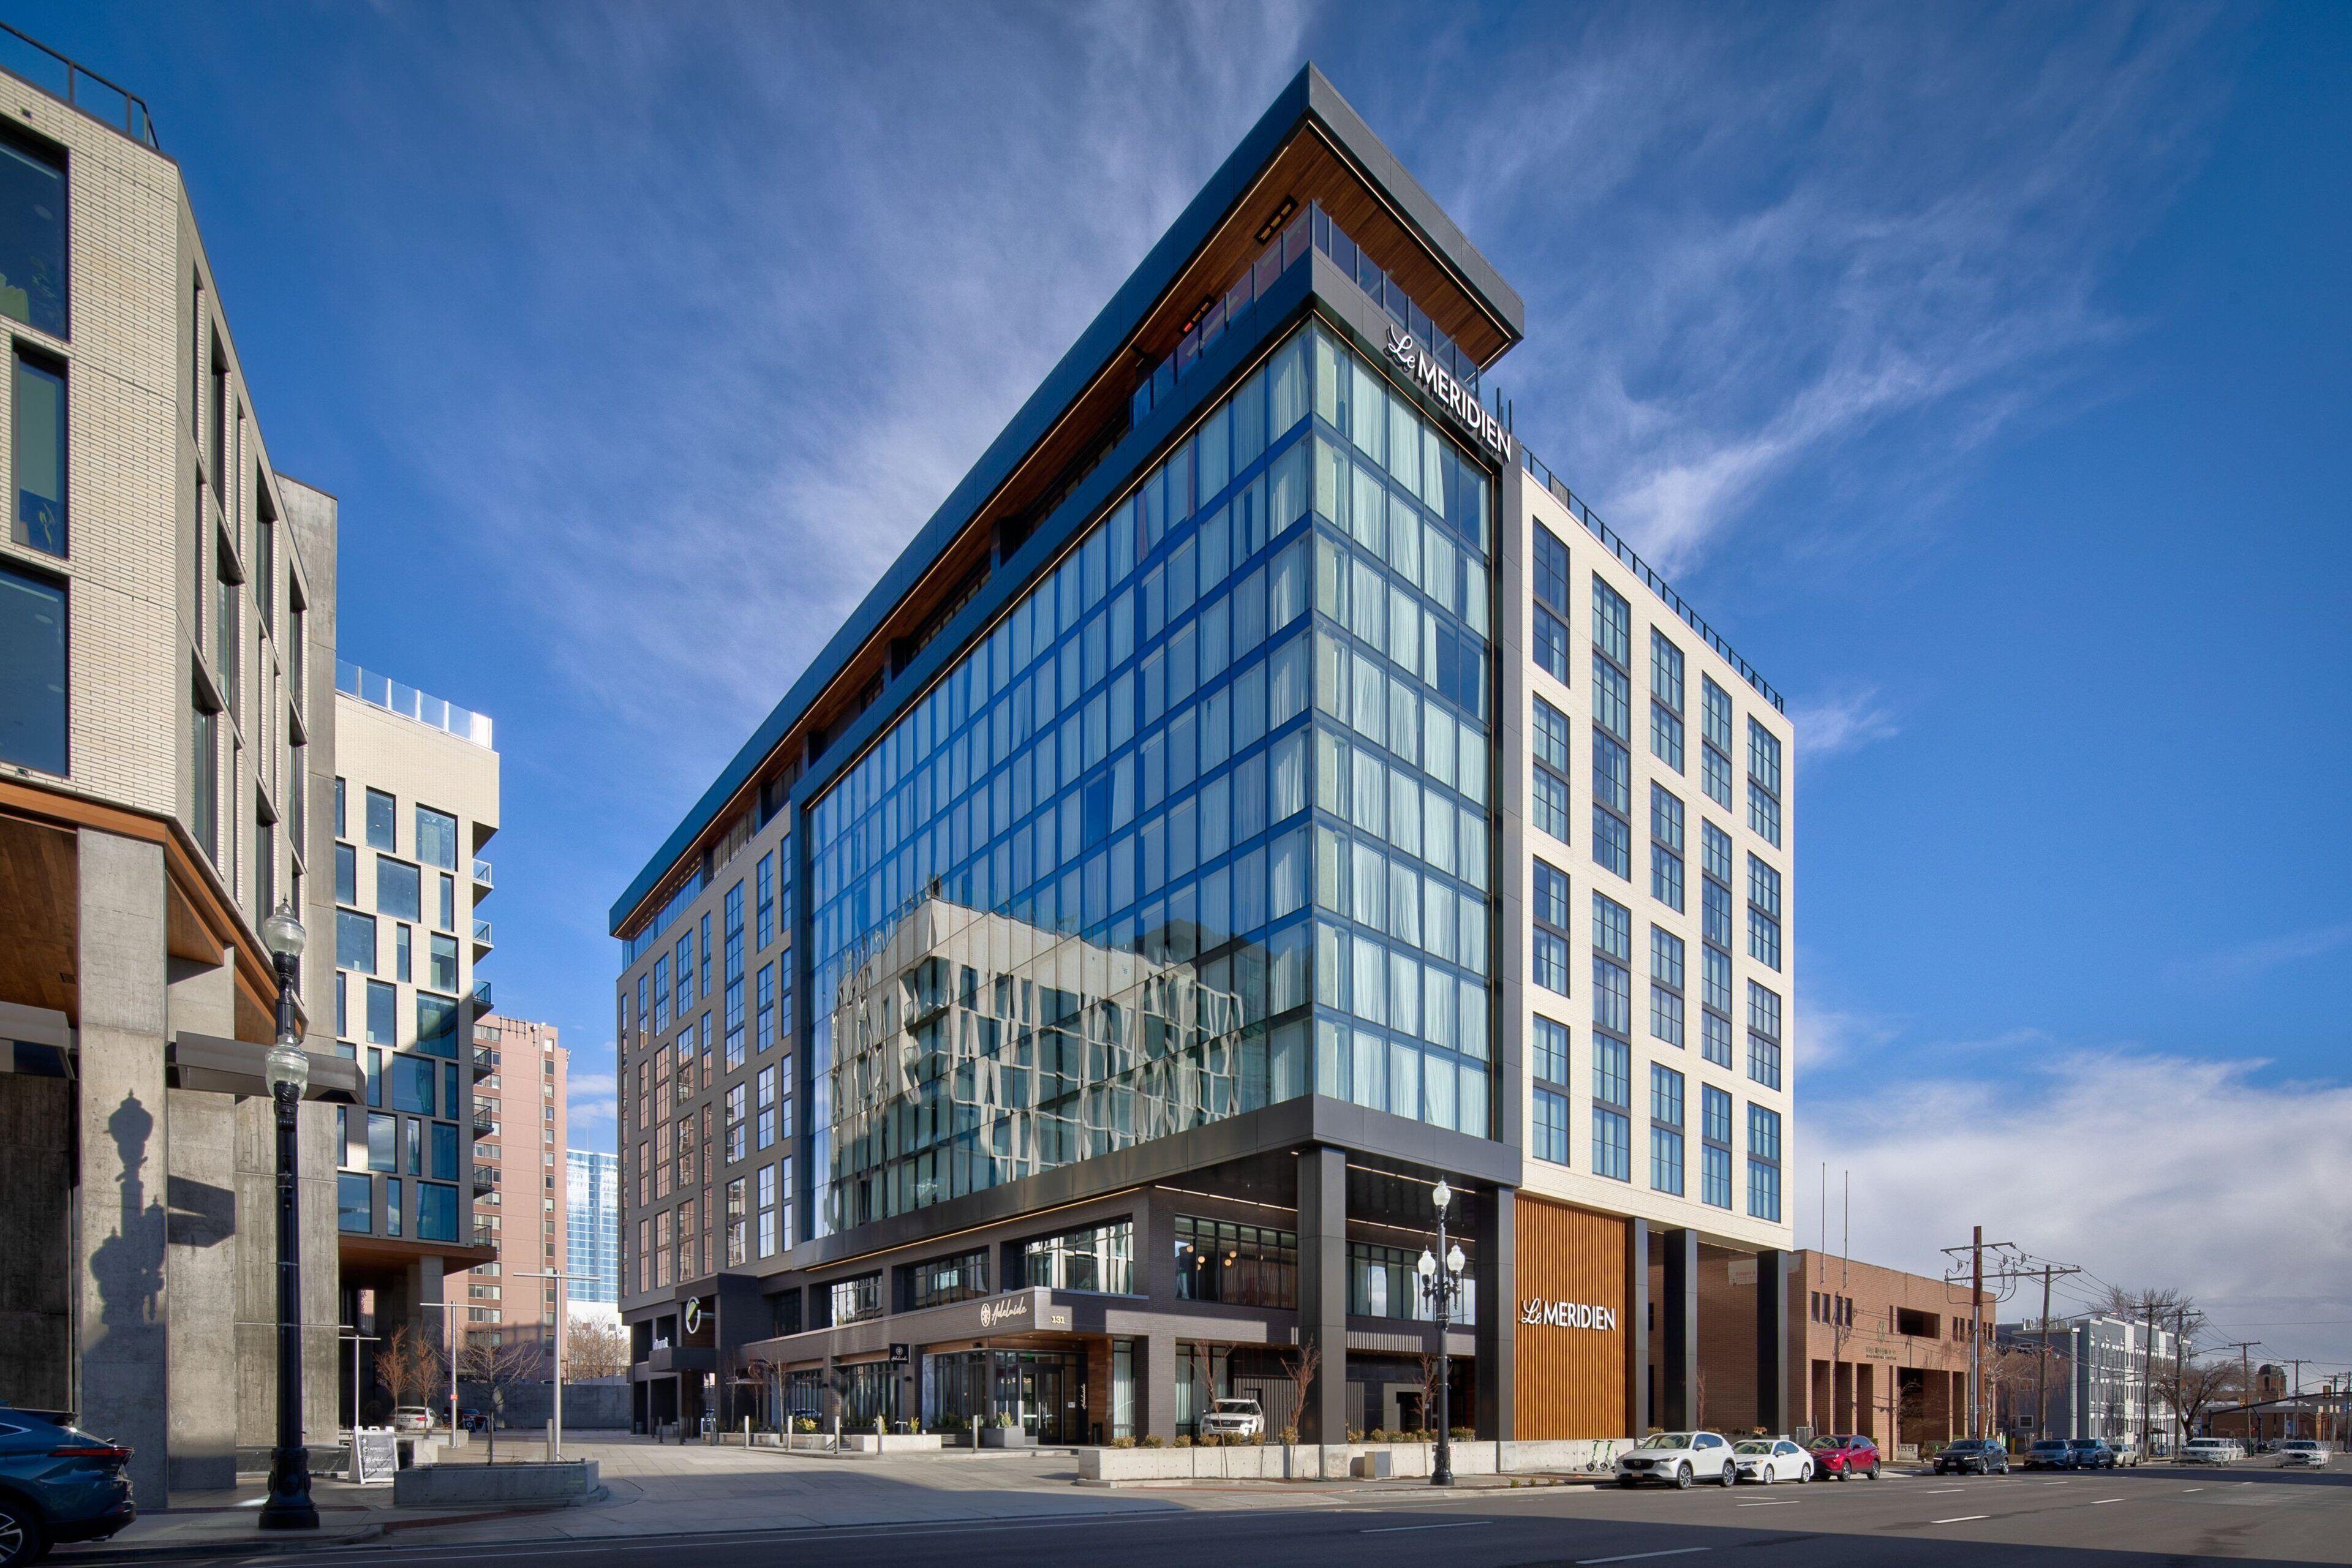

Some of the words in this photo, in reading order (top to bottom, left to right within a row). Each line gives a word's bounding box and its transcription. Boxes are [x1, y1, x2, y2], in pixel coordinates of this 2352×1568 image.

[1387, 324, 1415, 369] Le
[1418, 350, 1511, 462] MERIDIEN
[991, 1296, 1028, 1325] Adelaide
[1051, 1315, 1065, 1324] 131
[1521, 1297, 1542, 1324] Le
[1544, 1300, 1616, 1330] MERIDIEN
